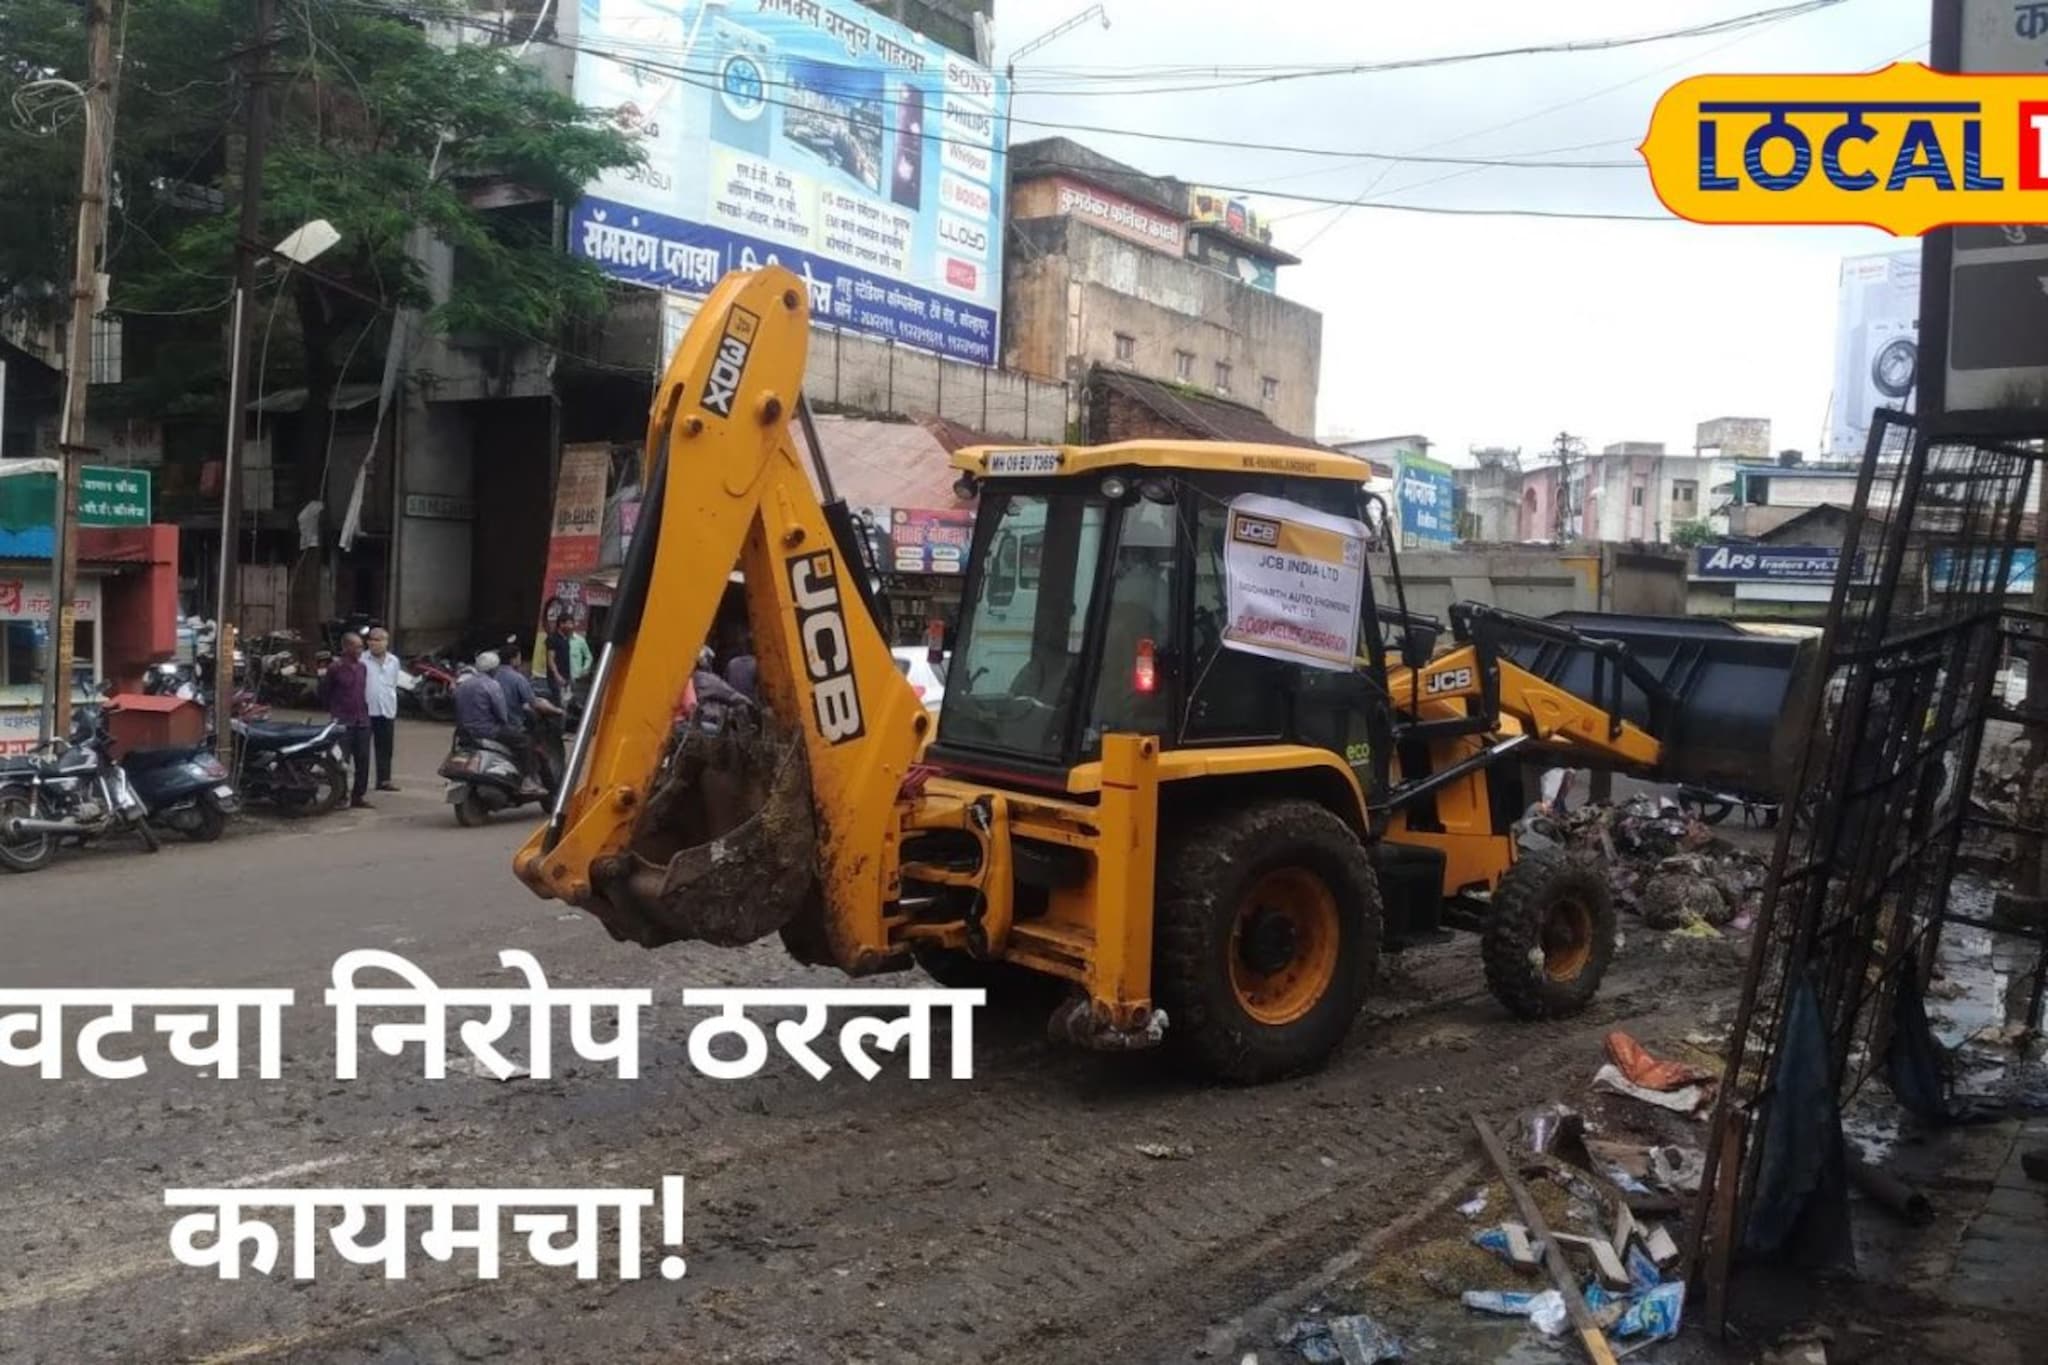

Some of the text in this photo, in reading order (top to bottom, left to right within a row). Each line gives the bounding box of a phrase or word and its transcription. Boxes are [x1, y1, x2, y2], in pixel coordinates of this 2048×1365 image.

[948, 63, 991, 97] SONY
[947, 101, 990, 137] PHILIPS
[940, 218, 985, 251] LLOYD
[704, 336, 748, 414] 3DX
[1239, 520, 1274, 539] JCB
[1259, 555, 1339, 582] JCB INDIA LTD
[1706, 548, 1756, 569] APS
[1289, 591, 1313, 604] AUTO
[792, 557, 861, 743] JCB
[1428, 669, 1471, 693] JCB
[1346, 743, 1370, 760] eco
